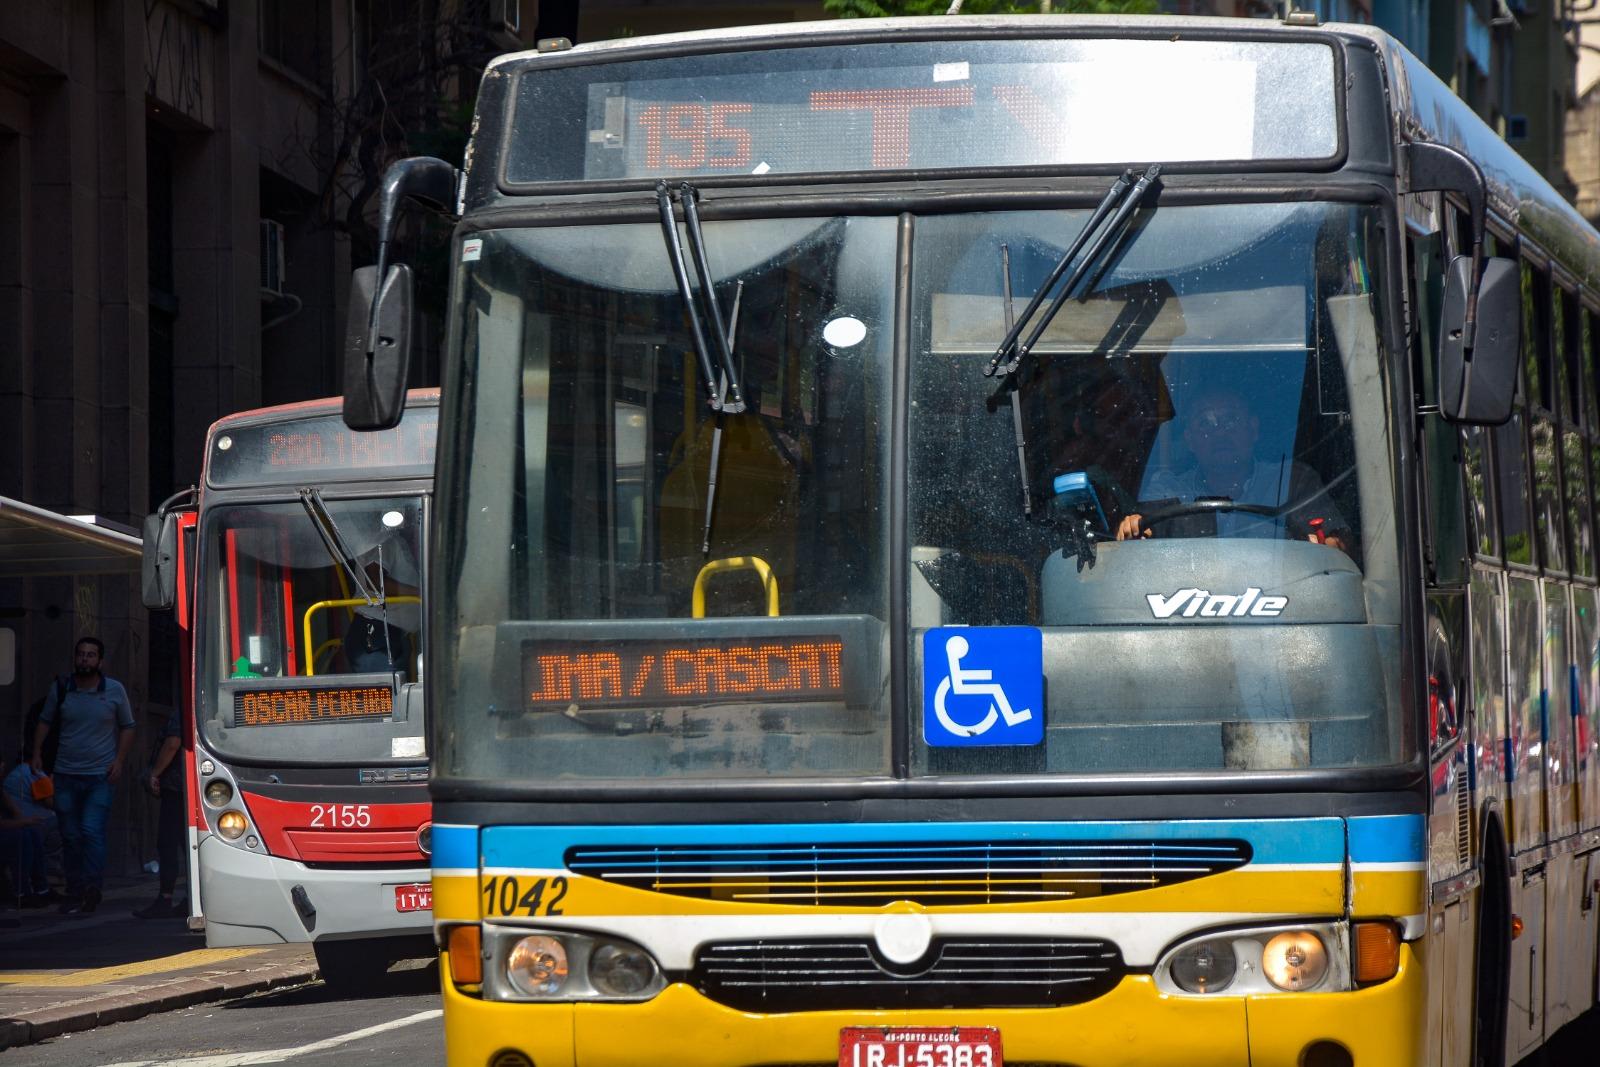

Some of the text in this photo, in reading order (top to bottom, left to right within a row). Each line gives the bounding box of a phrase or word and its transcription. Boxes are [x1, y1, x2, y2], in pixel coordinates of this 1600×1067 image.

[638, 103, 753, 169] 195
[1146, 587, 1288, 618] Viale
[532, 652, 622, 700] IMA
[662, 642, 843, 695] CASCAT
[243, 690, 313, 726] OSCAR
[310, 805, 372, 828] 2155
[483, 875, 568, 917] 1042
